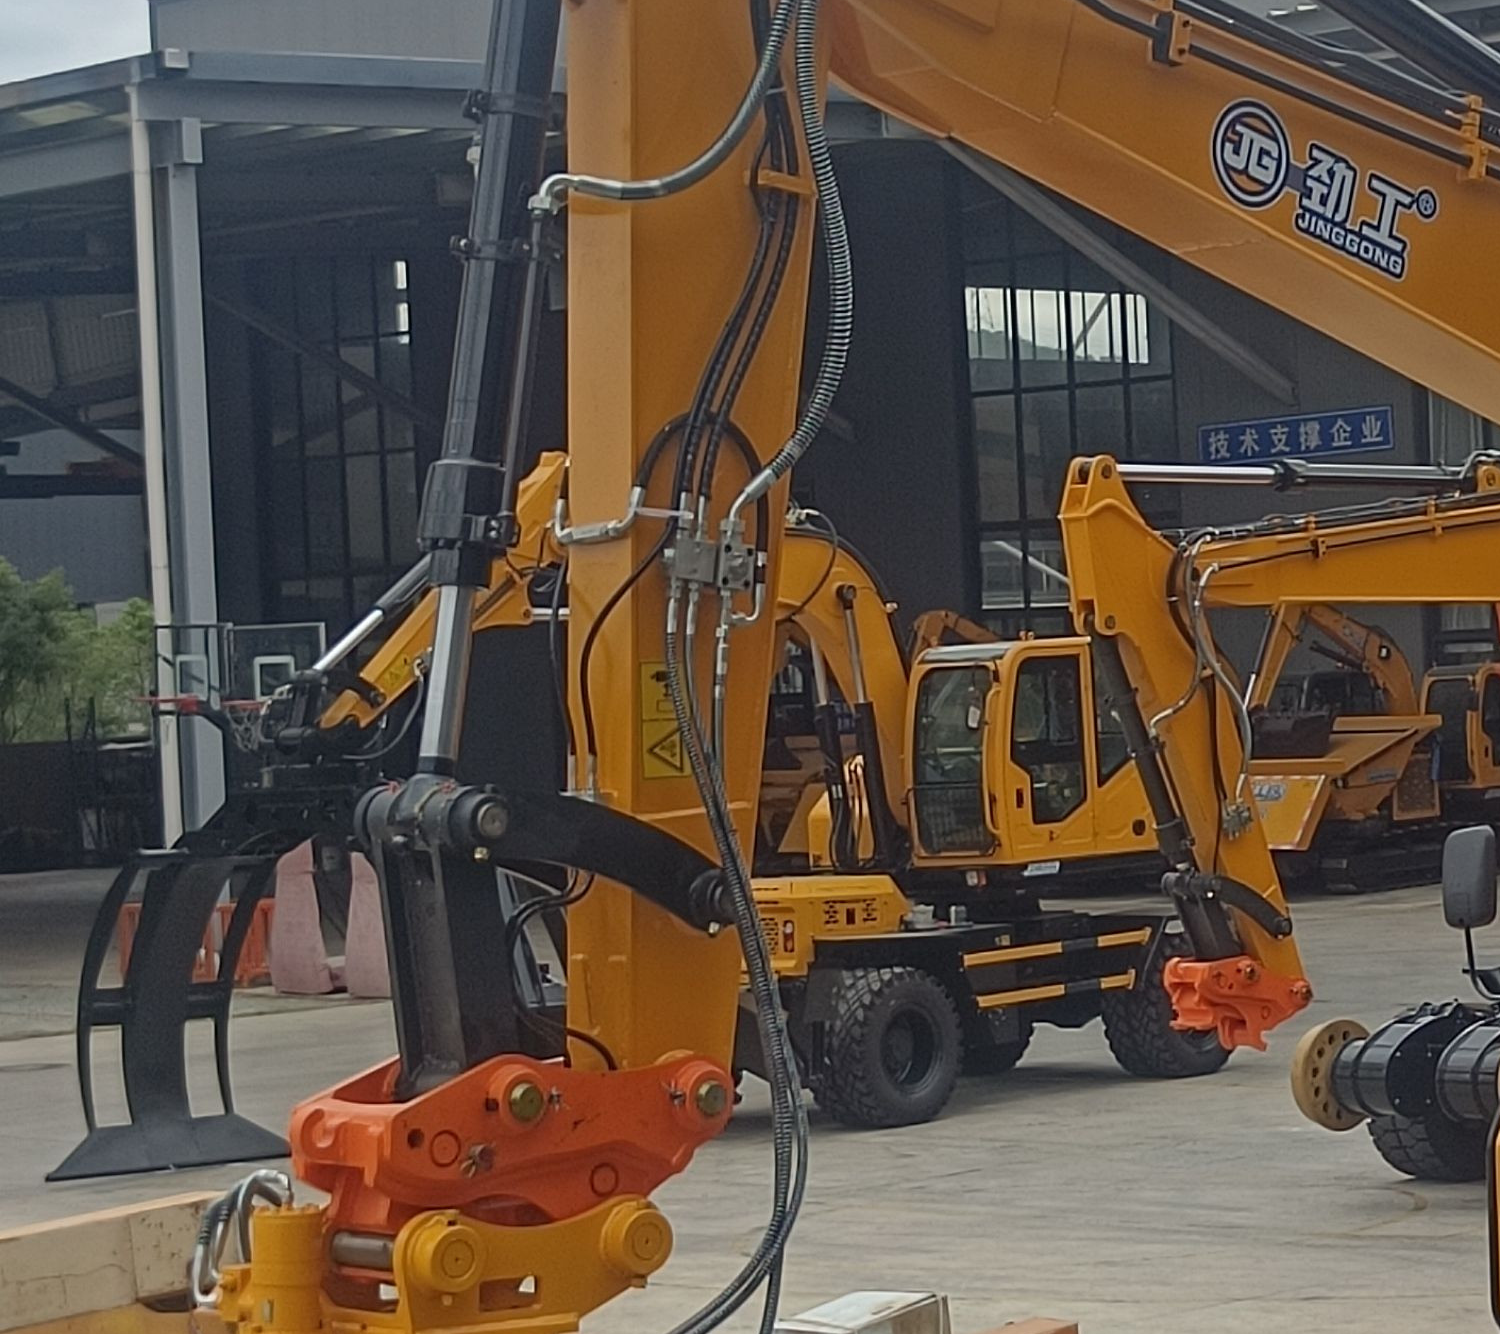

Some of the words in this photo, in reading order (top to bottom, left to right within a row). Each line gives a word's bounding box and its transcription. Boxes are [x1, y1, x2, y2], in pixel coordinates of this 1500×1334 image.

[1223, 122, 1280, 185] JG
[1297, 213, 1403, 275] JINGGONG
[1208, 414, 1384, 460] 技术支撑企业
